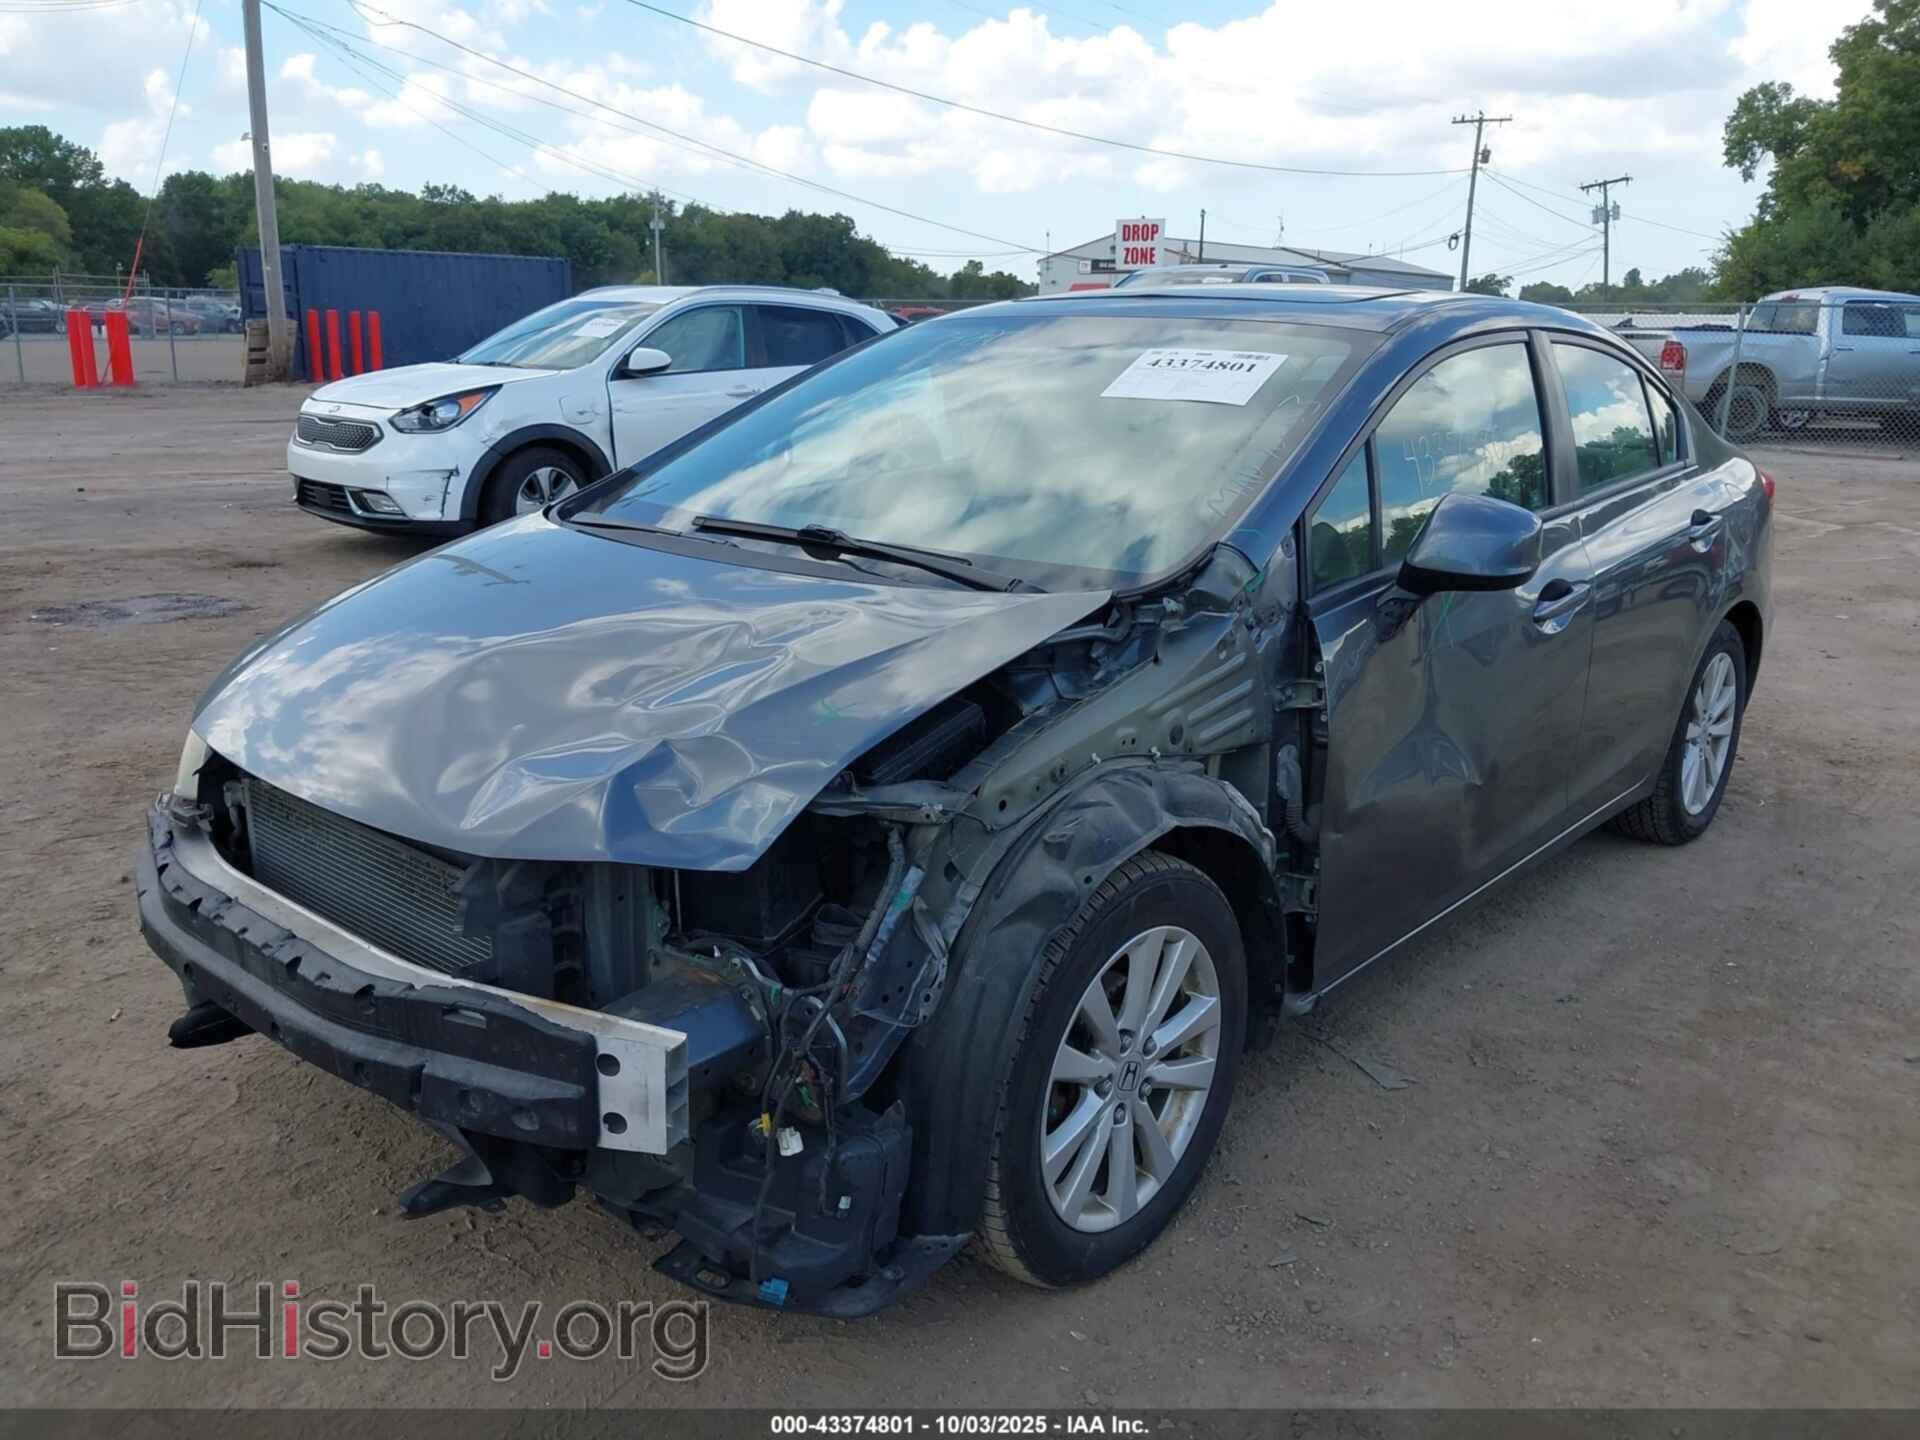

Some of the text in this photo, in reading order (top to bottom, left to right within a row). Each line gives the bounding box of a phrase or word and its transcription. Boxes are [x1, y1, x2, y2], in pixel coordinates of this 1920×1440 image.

[1122, 223, 1159, 242] DROP
[1122, 246, 1157, 265] ZONE
[1146, 357, 1257, 373] 43374801
